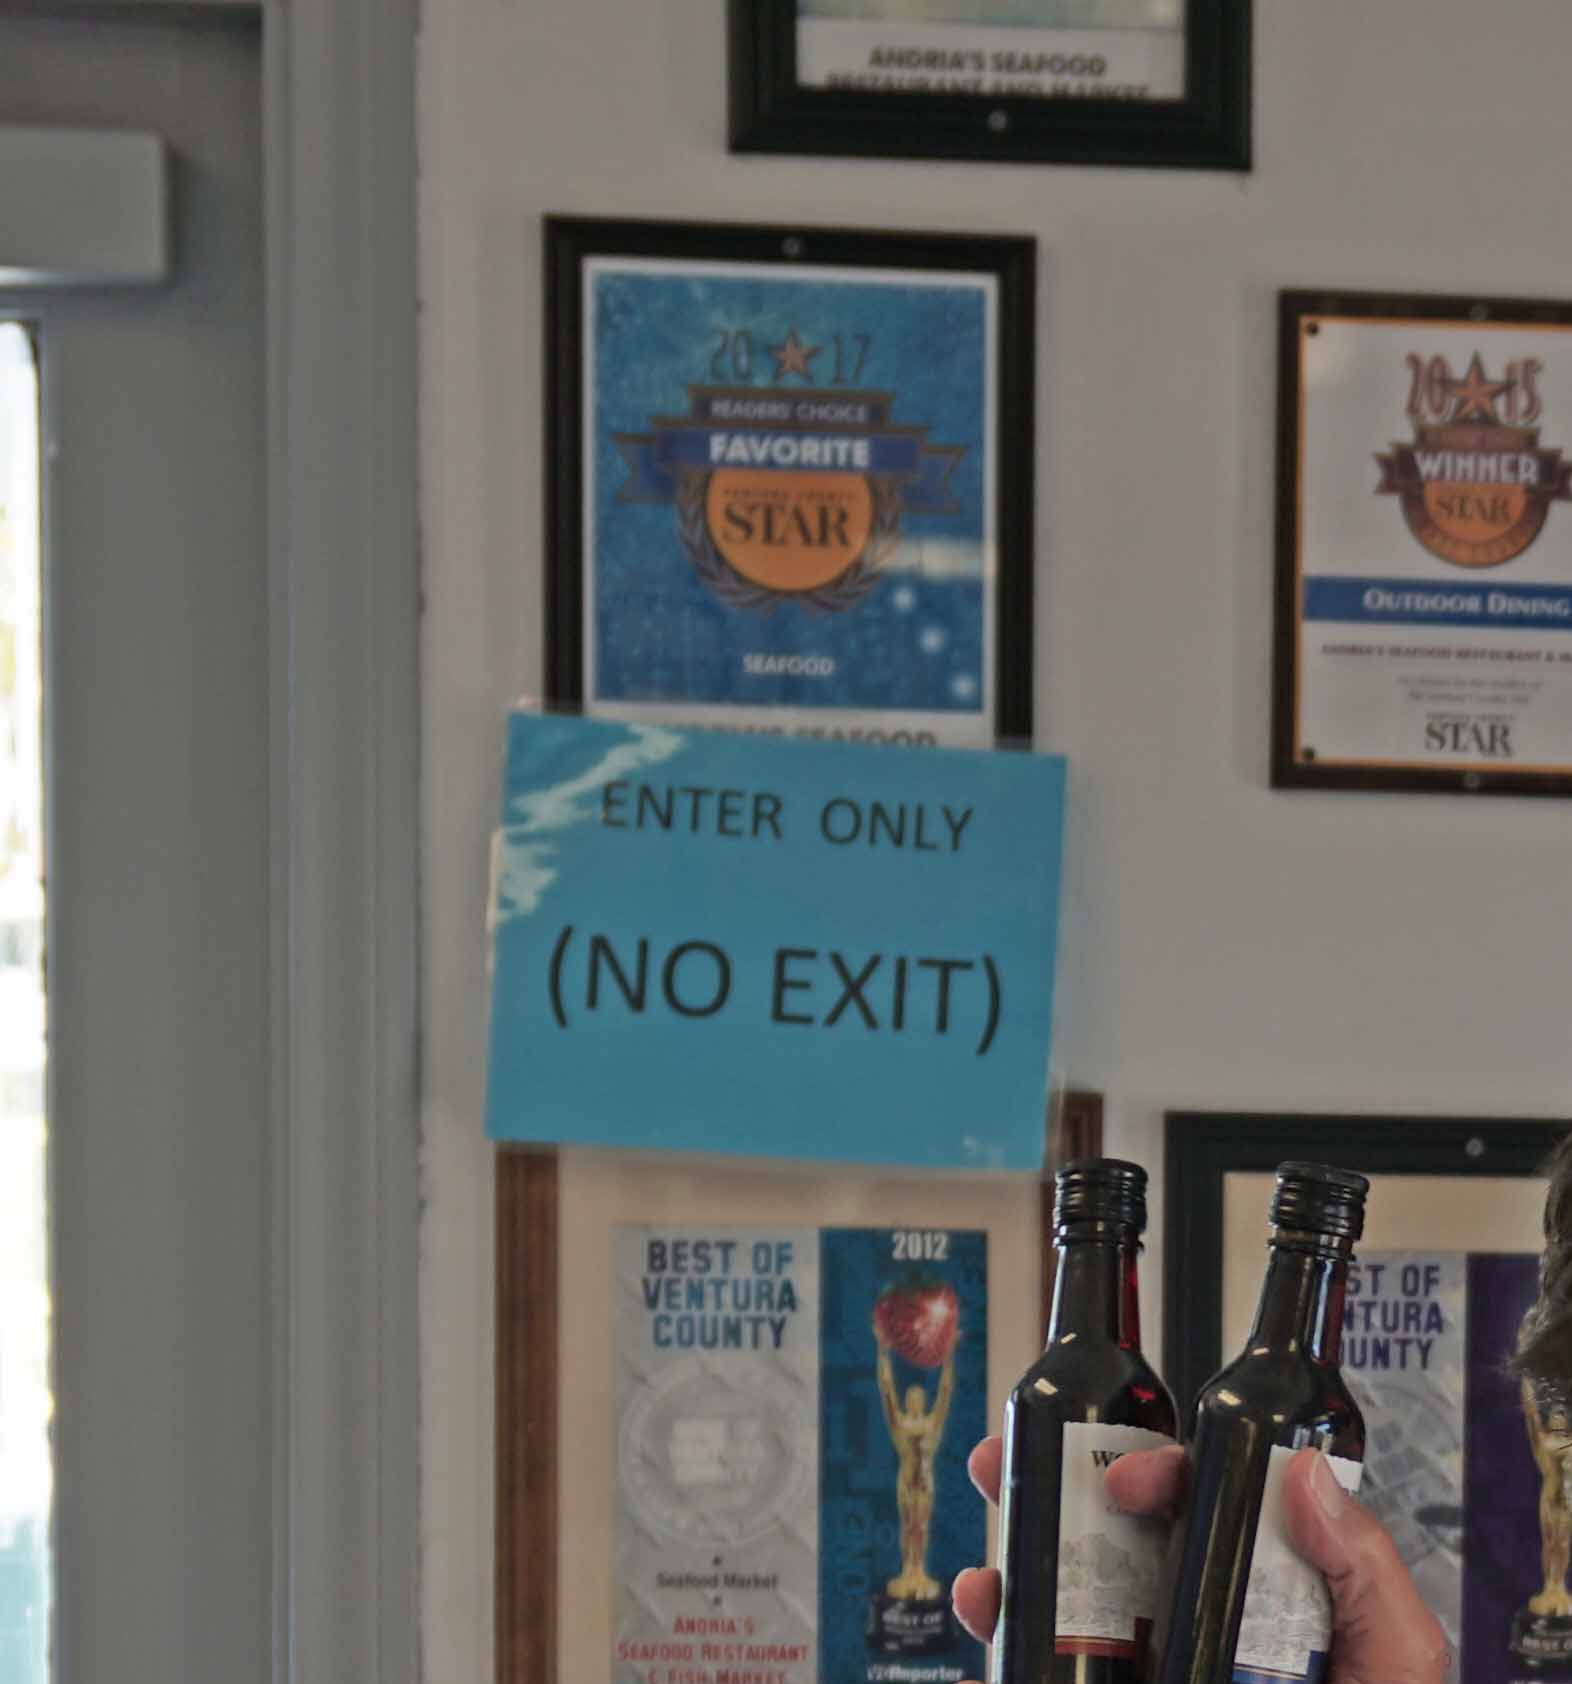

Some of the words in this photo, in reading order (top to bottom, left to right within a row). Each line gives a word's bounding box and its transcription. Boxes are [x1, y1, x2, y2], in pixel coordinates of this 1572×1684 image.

[869, 45, 985, 72] ANDRIA'S
[991, 51, 1107, 77] SEAFOOD
[708, 433, 870, 468] FAVORITE
[1415, 449, 1539, 485] WINNER
[723, 503, 851, 548] STAR
[1437, 495, 1513, 524] STAR
[1363, 588, 1481, 615] OUTDOOR
[1488, 590, 1572, 618] DINING
[742, 652, 837, 678] SEAFOOD
[1424, 721, 1514, 758] STAR
[602, 779, 784, 840] ENTER
[820, 796, 974, 852] ONLY
[549, 925, 733, 1029] (NO
[770, 946, 1003, 1056] EXIT)
[647, 1240, 737, 1275] BEST
[752, 1242, 794, 1274] OF
[891, 1231, 949, 1261] 2012
[641, 1278, 799, 1314] VENTURA
[1345, 1264, 1385, 1297] ST
[1401, 1264, 1441, 1297] OF
[652, 1315, 788, 1350] COUNTY
[1343, 1301, 1444, 1333] NTURA
[1340, 1336, 1433, 1369] UNTY
[723, 1573, 779, 1591] Market
[617, 1640, 694, 1663] SEAFOOD
[701, 1643, 809, 1663] RESTAURANT
